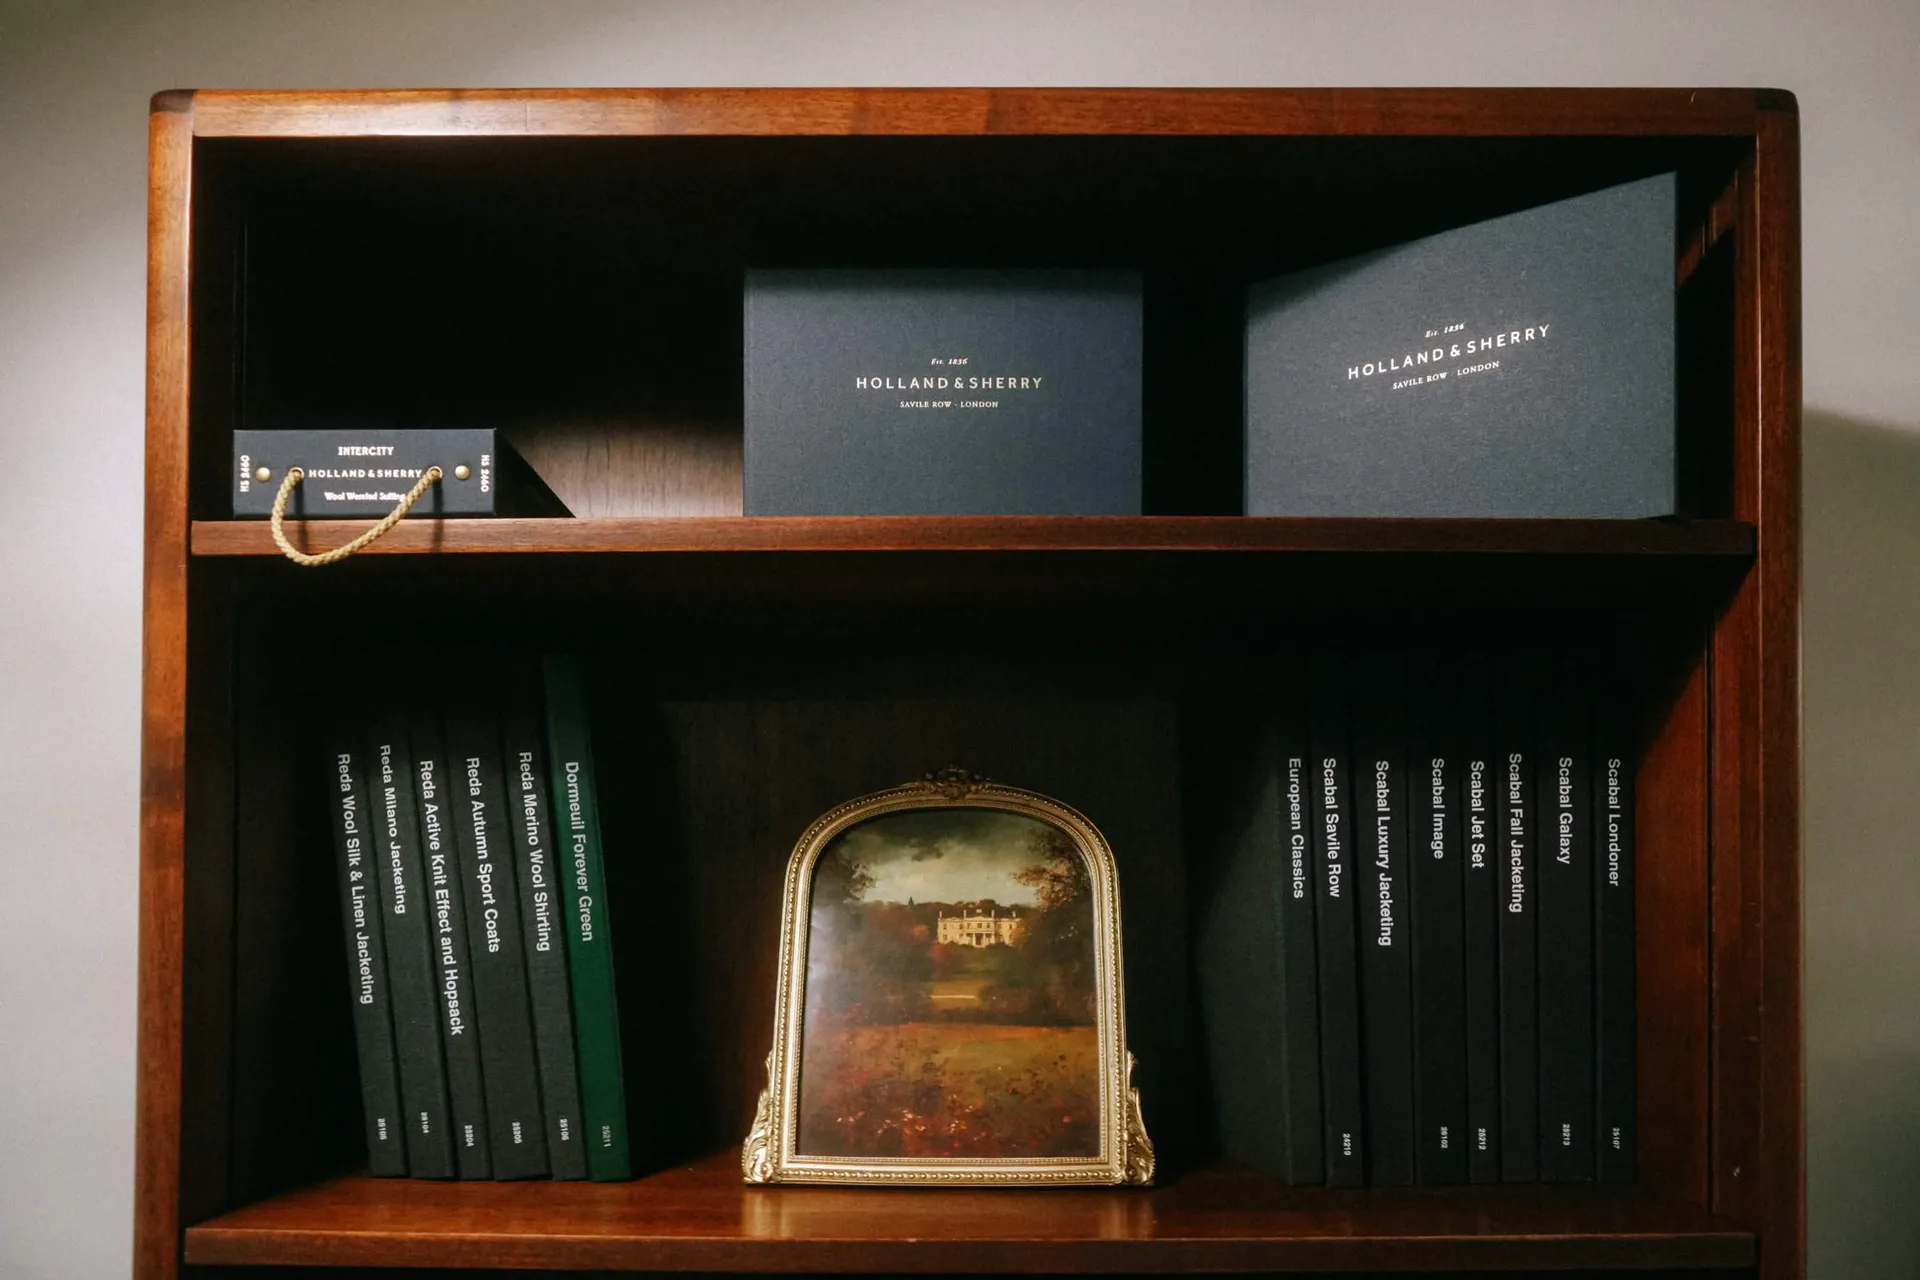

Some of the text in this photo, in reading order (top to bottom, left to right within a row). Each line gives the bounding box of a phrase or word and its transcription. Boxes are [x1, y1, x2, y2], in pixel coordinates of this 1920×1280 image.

[856, 377, 1042, 389] HOLLAND & SHERRY
[1348, 324, 1549, 382] HOLLAND & SHERRY
[1393, 361, 1499, 390] SAVILE ROW LONDON
[240, 455, 251, 492] HS 2460
[309, 469, 422, 478] HOLLAND & SHERRY
[324, 492, 346, 501] Wool
[345, 491, 378, 501] Worsted
[338, 446, 394, 456] INTERCITY
[480, 454, 490, 492] HS 2460
[380, 745, 406, 914] Reda Milano Jacketing
[467, 758, 500, 953] Reda Autumn Sport Coats
[519, 752, 551, 951] Reda Merino Wool Shirting
[566, 762, 593, 941] Dormeuil Forever Green
[1287, 758, 1306, 899] European Classics
[1323, 758, 1341, 897] Scabal Savile Row
[1375, 761, 1394, 946] Scabal Luxury Jacketing
[1430, 758, 1445, 859] Scabal Image
[1471, 761, 1485, 868] Scabal Jet Set
[1508, 754, 1525, 913] Scabal Fall Jacketing
[1556, 757, 1573, 864] Scabal Galaxy
[1608, 759, 1621, 886] Scabal Londoner
[338, 754, 374, 1004] Reda Wool Silk & Linen Jacketing
[420, 761, 464, 1035] Reda Active Knit Effect and Hopsack
[1478, 1128, 1486, 1150] 25212
